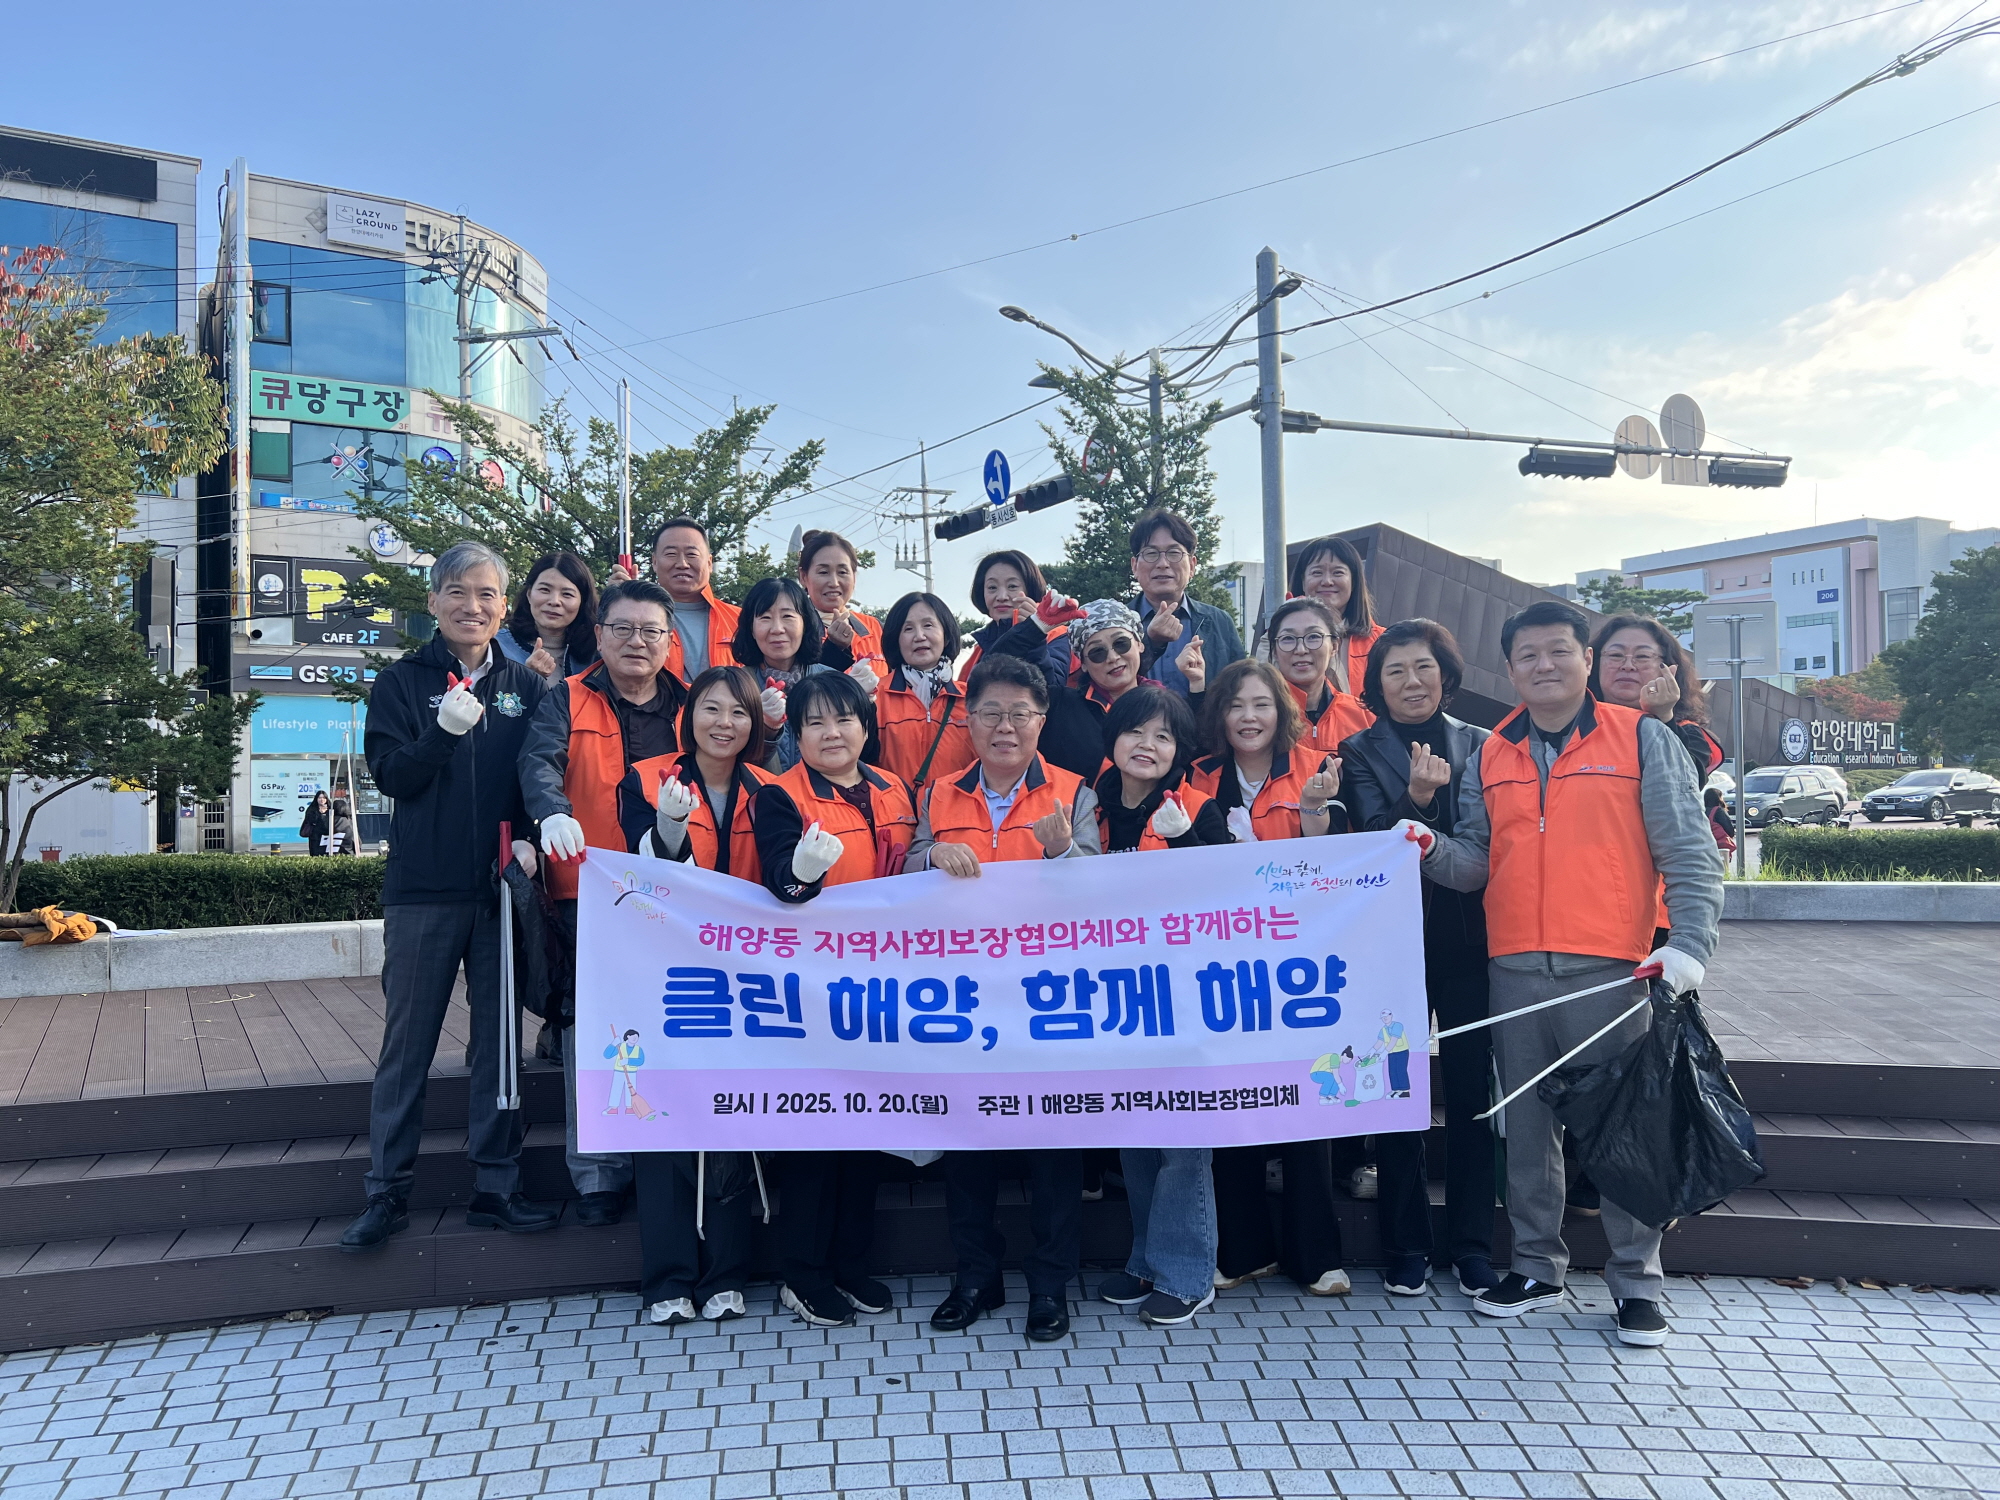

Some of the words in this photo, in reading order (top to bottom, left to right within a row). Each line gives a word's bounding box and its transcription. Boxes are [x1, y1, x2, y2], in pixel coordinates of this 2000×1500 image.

[356, 208, 381, 219] LAZY
[356, 218, 398, 231] GROUND
[259, 377, 404, 422] 큐당구장
[991, 506, 1016, 525] 동시신호
[1821, 592, 1834, 600] 206
[322, 632, 354, 644] CAFE
[357, 630, 380, 644] 2F
[299, 664, 357, 683] GS25
[262, 719, 318, 731] Lifestyle
[327, 719, 366, 730] Platfo
[1811, 720, 1896, 752] 한양대학교
[1810, 752, 1839, 764] Education
[1841, 752, 1868, 764] Research
[1869, 752, 1895, 766] Industry
[1897, 752, 1918, 764] Cluster
[1255, 861, 1293, 884] 시민과
[1269, 881, 1306, 897] 자유로운
[1311, 878, 1352, 894] 혁신도시
[1356, 873, 1390, 889] 안산
[699, 923, 801, 958] 해양동
[814, 917, 1149, 961] 지역사회보장협의체와
[1160, 906, 1299, 945] 함께하는
[662, 967, 806, 1039] 클린
[826, 975, 998, 1051] 해양,
[1021, 963, 1175, 1040] 함께
[1195, 955, 1347, 1032] 해양
[713, 1093, 754, 1114] 일시
[776, 1092, 837, 1114] 2025.
[843, 1092, 872, 1113] 10.
[878, 1093, 949, 1115] 20.(월)
[977, 1095, 1020, 1116] 주관
[1041, 1092, 1104, 1115] 해양동
[1111, 1084, 1300, 1112] 지역사회보장협의체
